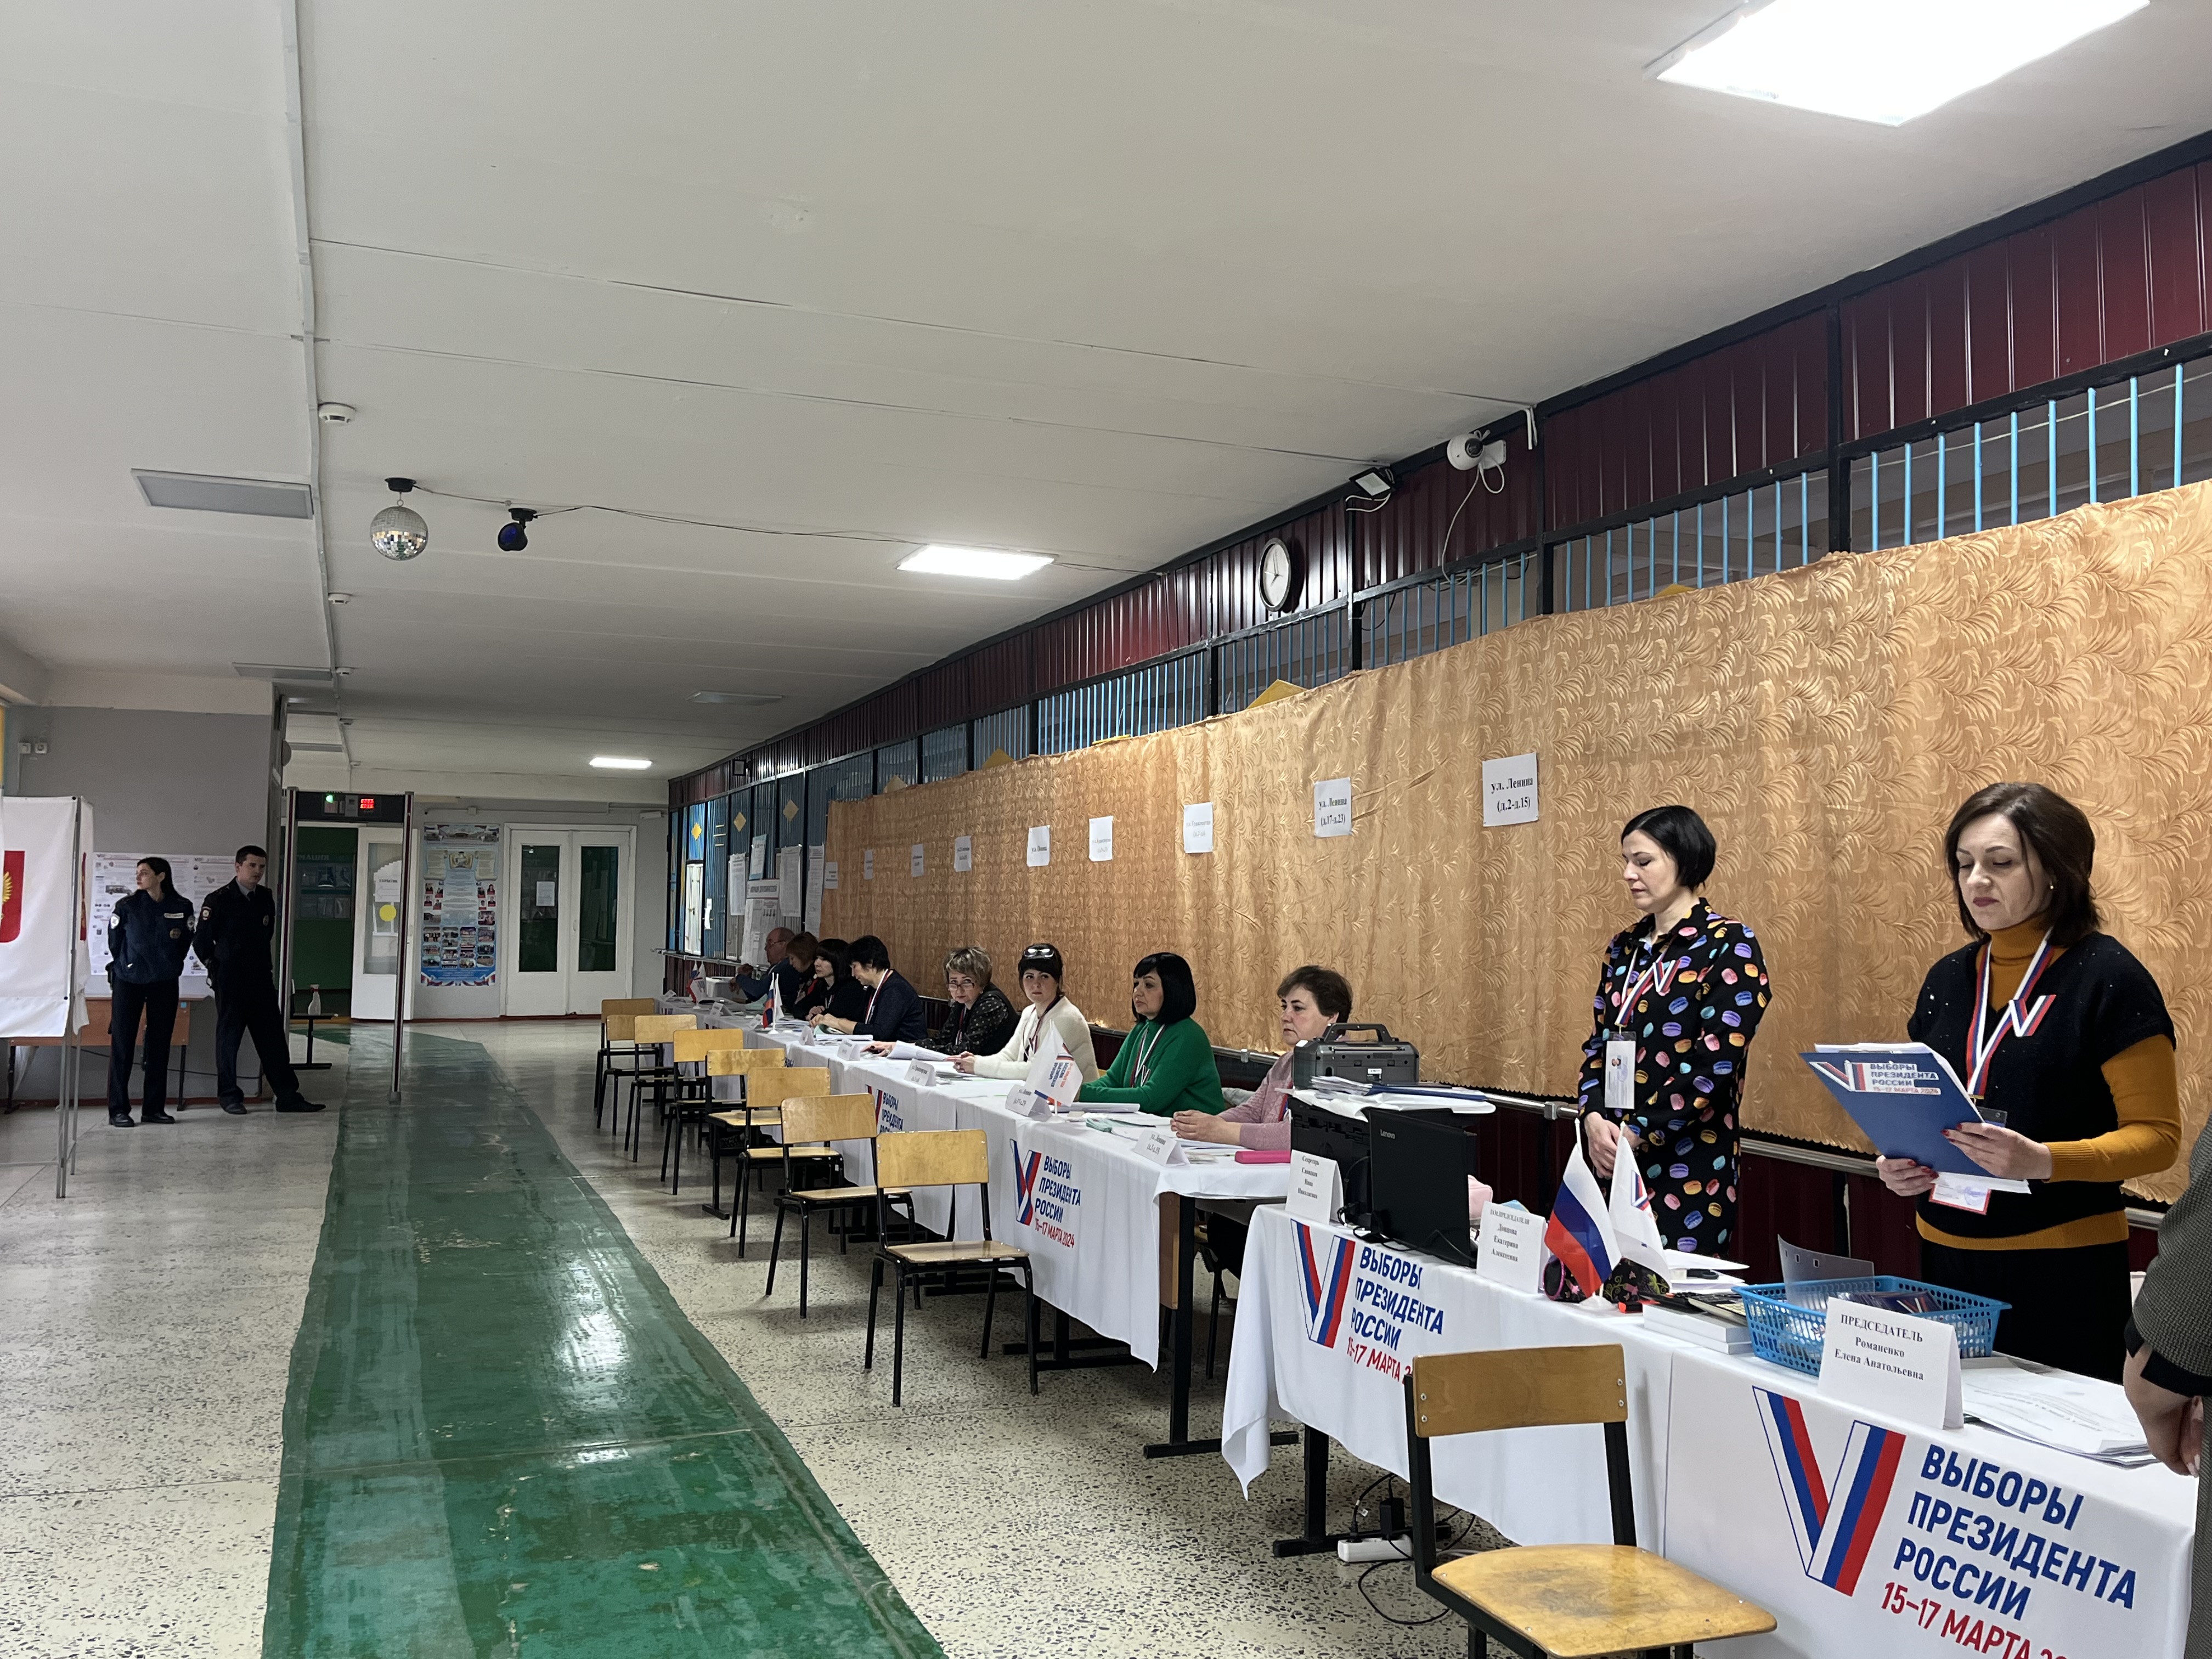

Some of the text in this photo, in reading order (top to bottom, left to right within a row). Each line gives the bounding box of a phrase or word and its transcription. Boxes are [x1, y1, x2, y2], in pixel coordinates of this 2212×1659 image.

[1491, 777, 1533, 794] ул. Ленина
[1497, 797, 1531, 812] (д.2-д.15)
[1380, 1128, 1396, 1139] Lenovo
[1043, 1155, 1072, 1181] ВЫБОРЫ
[1039, 1177, 1081, 1206] ПРЕЗИДЕНТА
[1035, 1198, 1064, 1223] РОССИИ
[1047, 1224, 1063, 1244] МАРТА
[1359, 1246, 1423, 1290] ВЫБОРЫ
[1355, 1277, 1444, 1335] ПРЕЗИДЕНТА
[1351, 1307, 1402, 1351] РОССИИ
[1841, 1314, 1923, 1342] ПРЕДСЕДАТЕЛЬ
[1855, 1336, 1905, 1358] Романенко
[1366, 1348, 1401, 1383] МАРТА
[1835, 1348, 1923, 1380] Елена Анатольевна
[1920, 1443, 2084, 1531] ВЫБОРЫ
[1908, 1491, 2136, 1610] ПРЕЗИДЕНТА
[1893, 1537, 2032, 1621] РОССИИ
[1940, 1609, 2032, 1659] МАРТА
